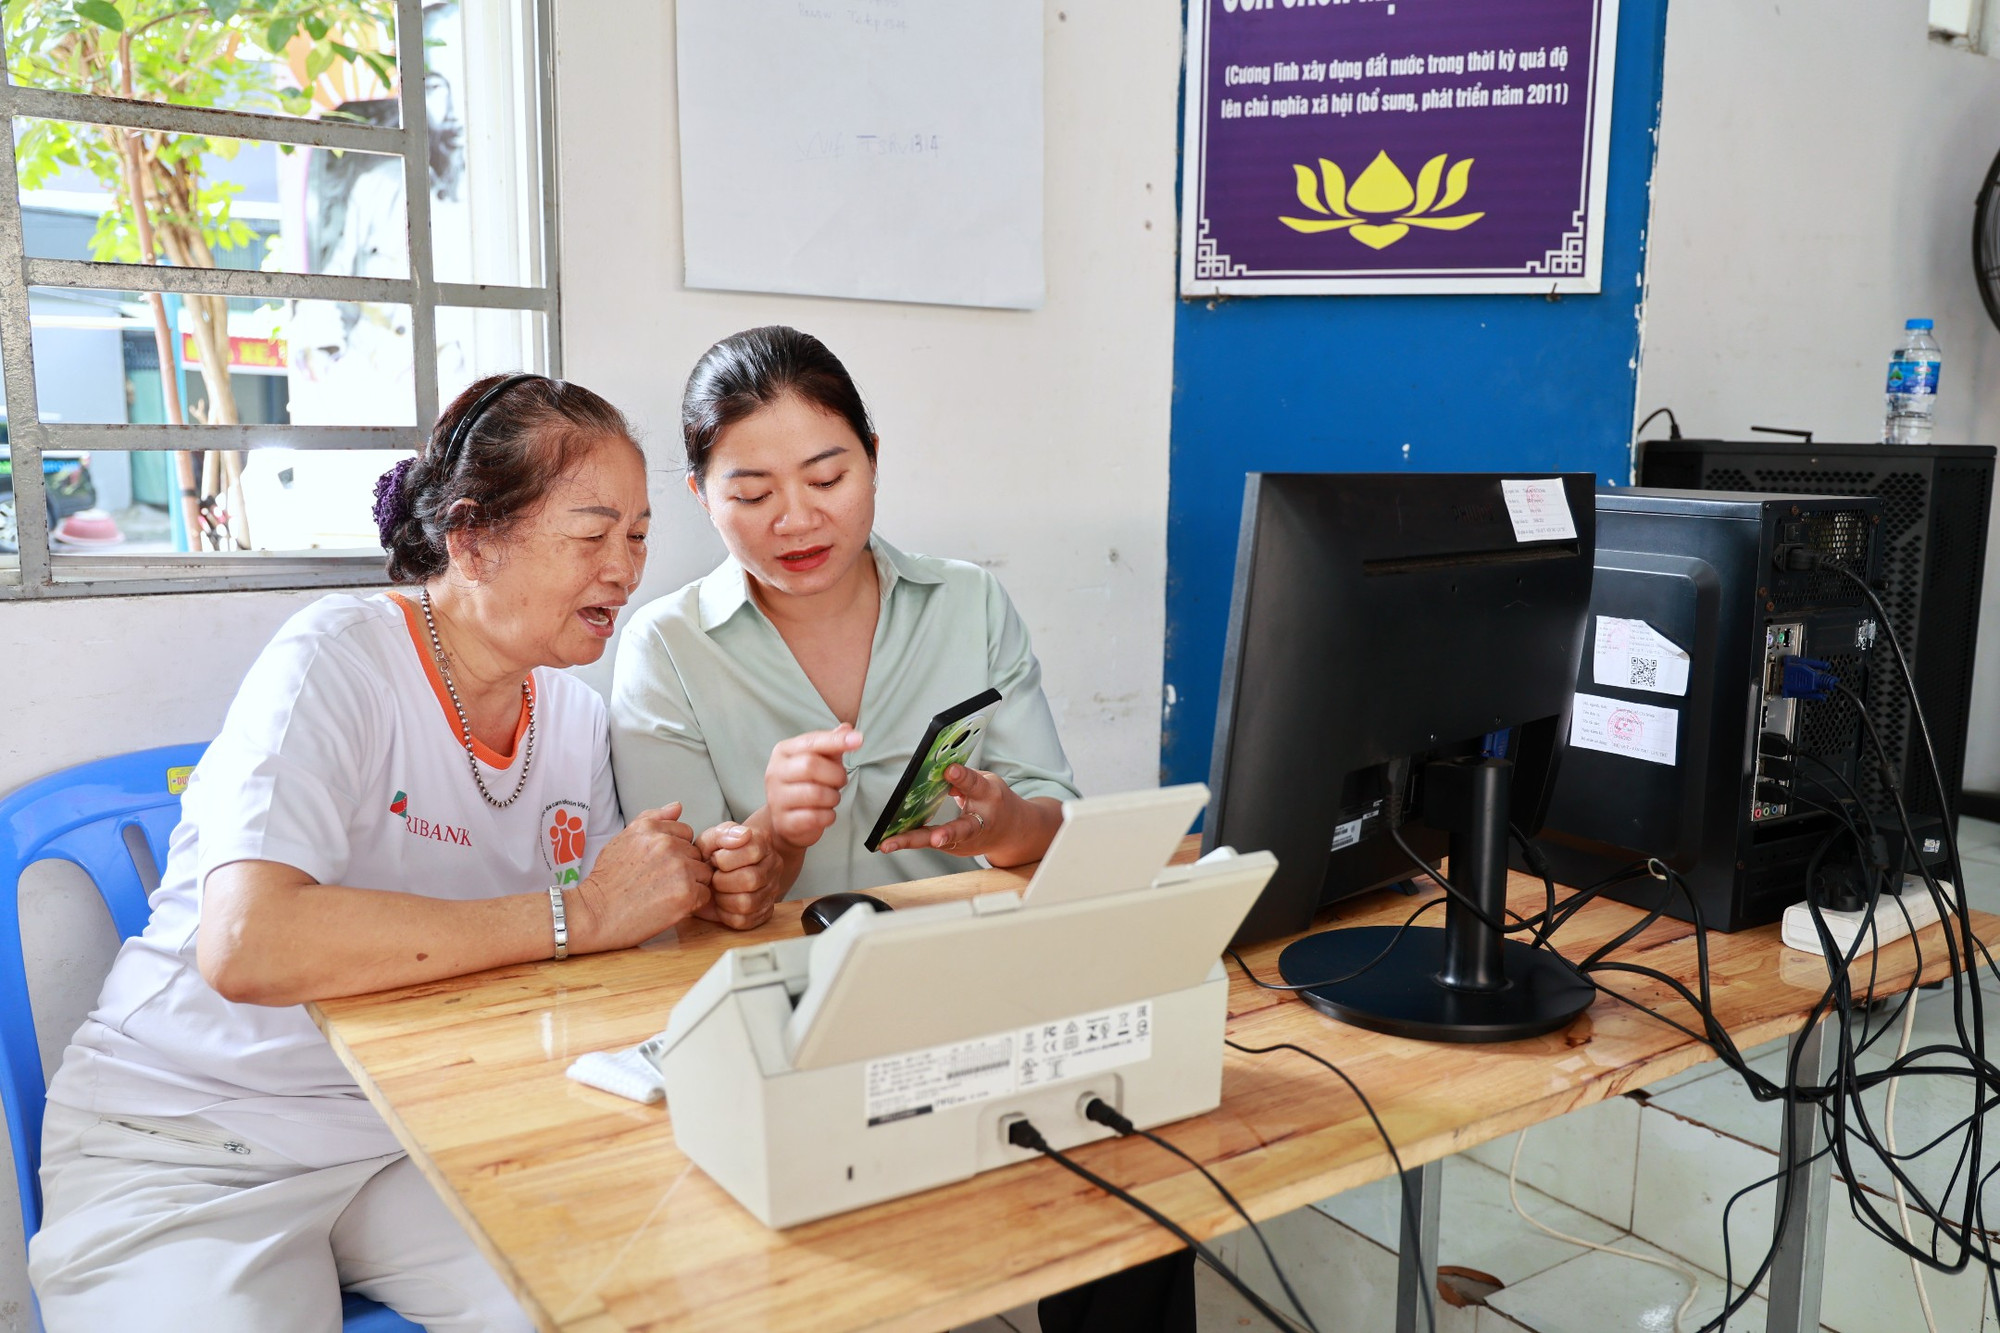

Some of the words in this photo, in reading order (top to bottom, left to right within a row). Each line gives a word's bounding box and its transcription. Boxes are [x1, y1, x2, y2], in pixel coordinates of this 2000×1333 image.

[1225, 64, 1271, 87] (Cương
[1273, 61, 1299, 82] lĩnh
[1302, 59, 1326, 82] xây
[1329, 58, 1362, 83] dựng
[1365, 52, 1388, 77] đất
[1390, 53, 1425, 76] nước
[1427, 53, 1465, 75] trong
[1467, 49, 1495, 72] thời
[1498, 48, 1516, 73] kỳ
[1518, 46, 1546, 71] quá
[1549, 45, 1569, 72] độ
[1220, 98, 1242, 119] lên
[1244, 94, 1269, 117] chủ
[1271, 95, 1308, 118] nghĩa
[1311, 94, 1329, 114] xã
[1331, 92, 1353, 117] hội
[1356, 87, 1381, 115] (bổ
[1381, 91, 1419, 113] sung,
[1421, 87, 1453, 112] phát
[1455, 81, 1489, 108] triển
[1492, 84, 1524, 106] năm
[1526, 82, 1569, 105] 2011)
